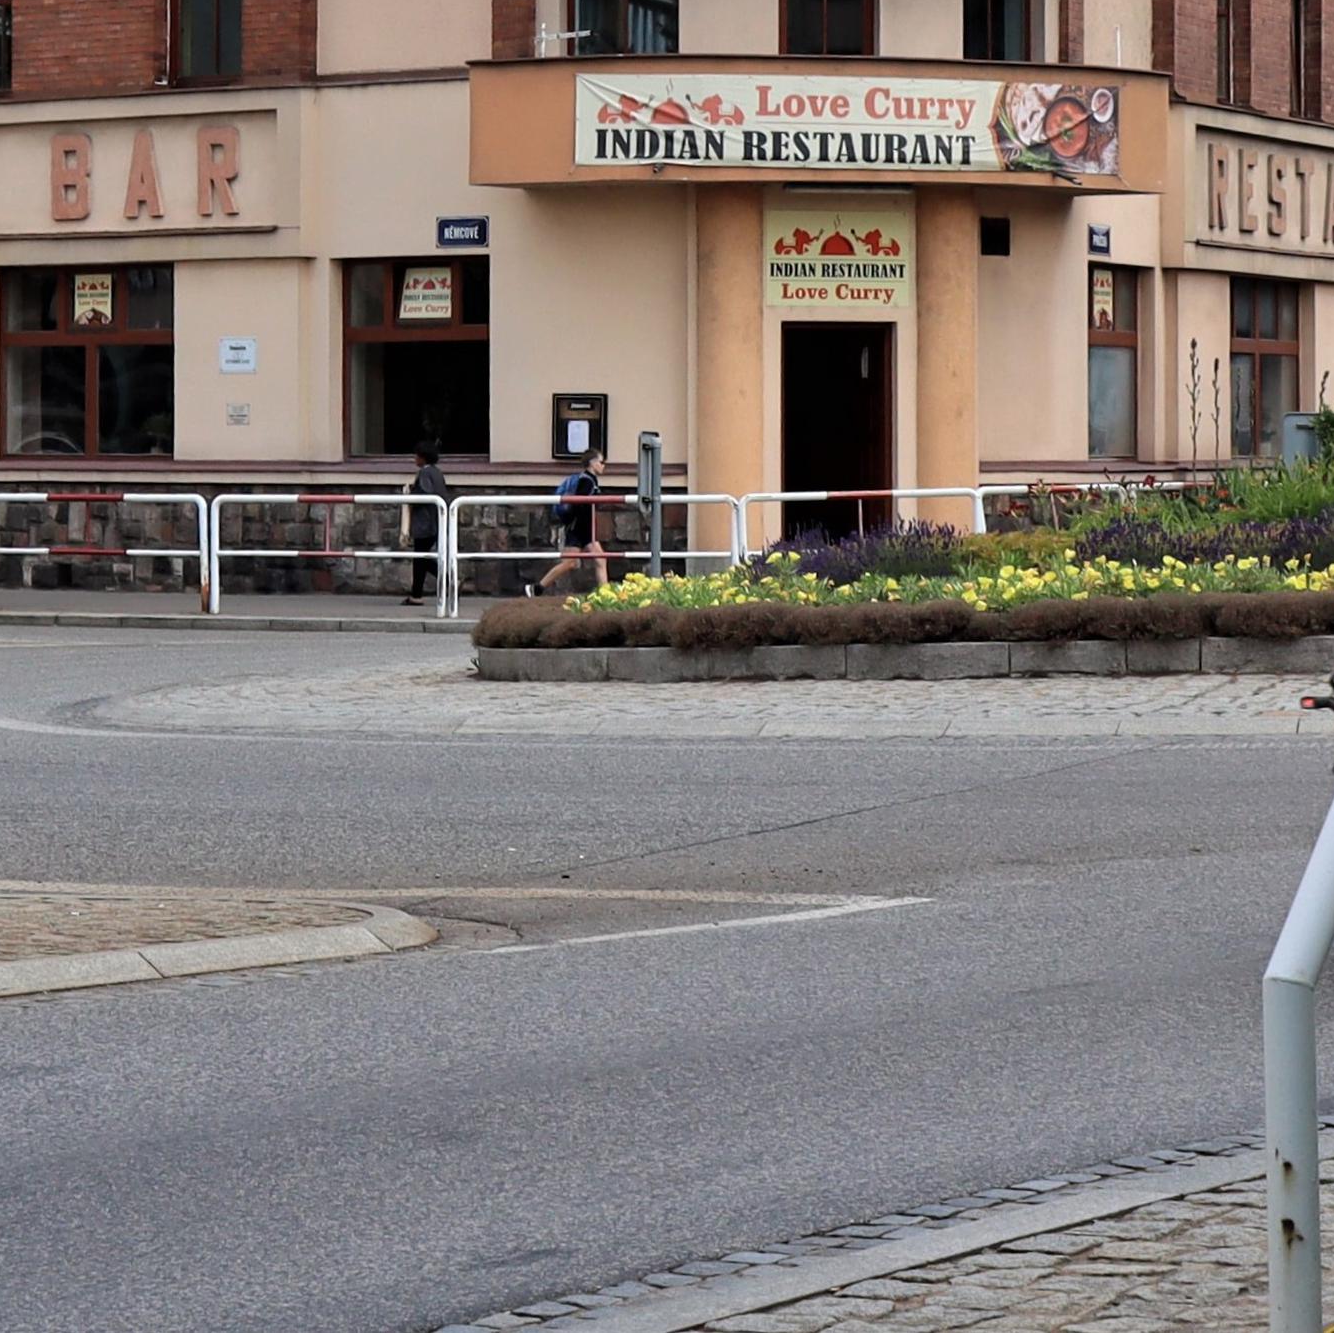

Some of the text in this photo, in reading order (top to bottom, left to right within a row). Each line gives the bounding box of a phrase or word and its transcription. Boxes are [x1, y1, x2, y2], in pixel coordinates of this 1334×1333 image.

[755, 85, 976, 130] Love Curry
[595, 128, 976, 166] INDIAN RESTAURANT
[50, 125, 240, 222] BAR
[770, 262, 906, 279] INDIAN RESTAURANT
[781, 283, 895, 304] Love Curry
